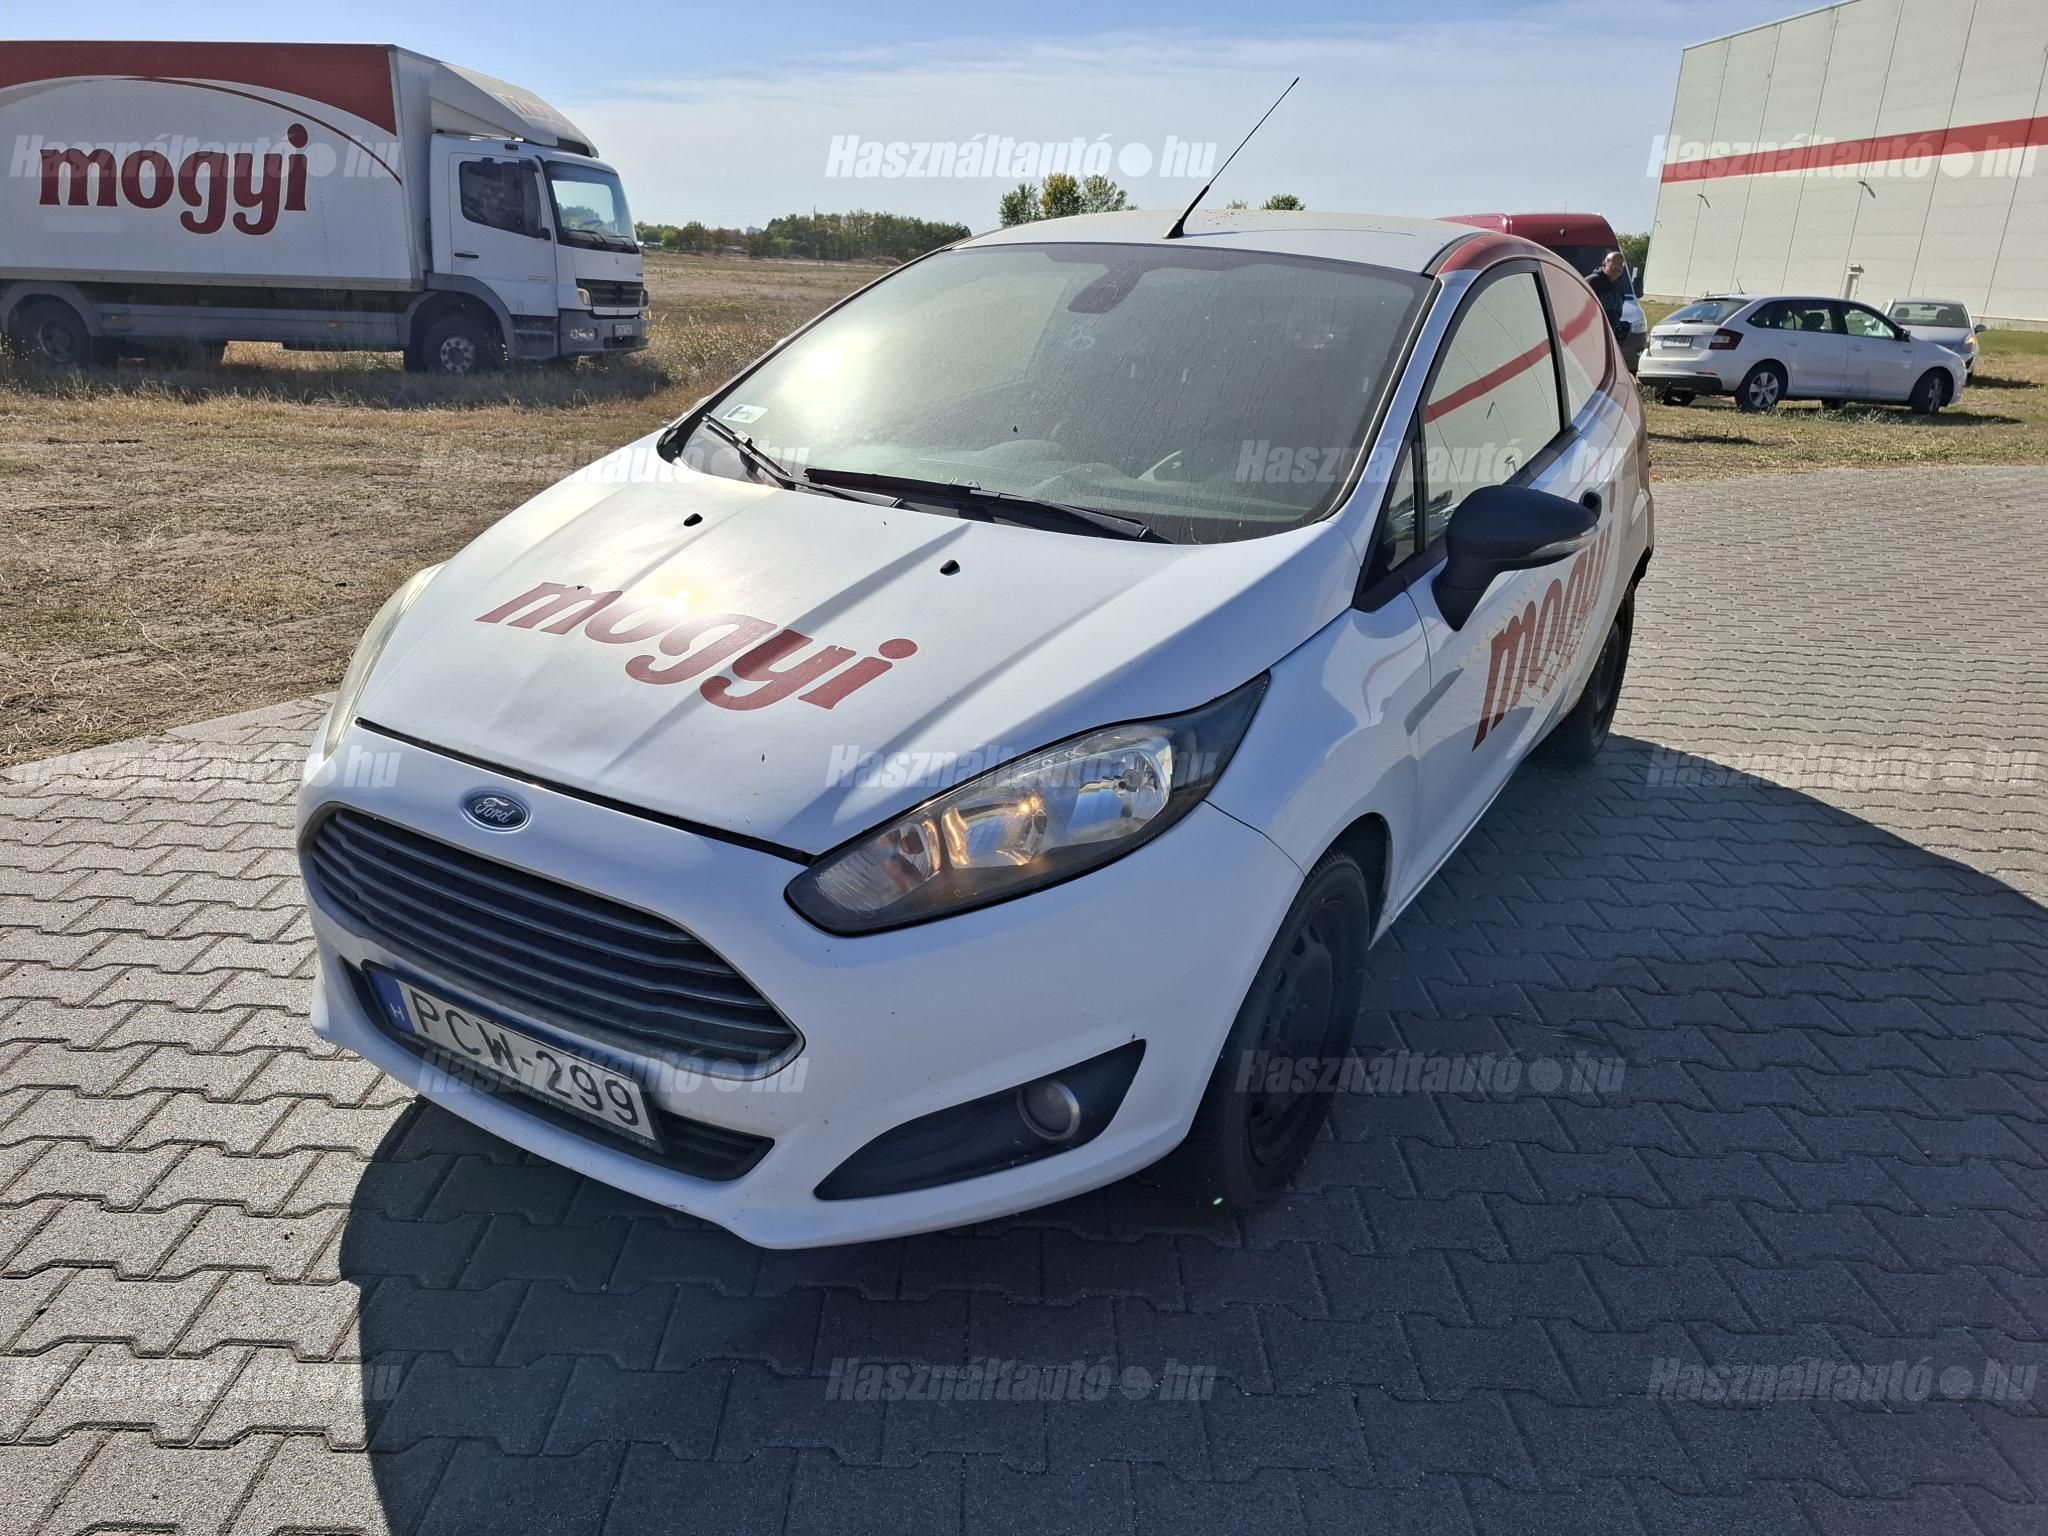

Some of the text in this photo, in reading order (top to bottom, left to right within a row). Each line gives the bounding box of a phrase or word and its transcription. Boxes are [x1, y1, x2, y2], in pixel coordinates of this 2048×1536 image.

[38, 123, 309, 236] mogyi
[475, 581, 918, 711] mogyi
[474, 797, 516, 823] Ford
[389, 1002, 405, 1022] H
[408, 987, 640, 1127] PCW-299
